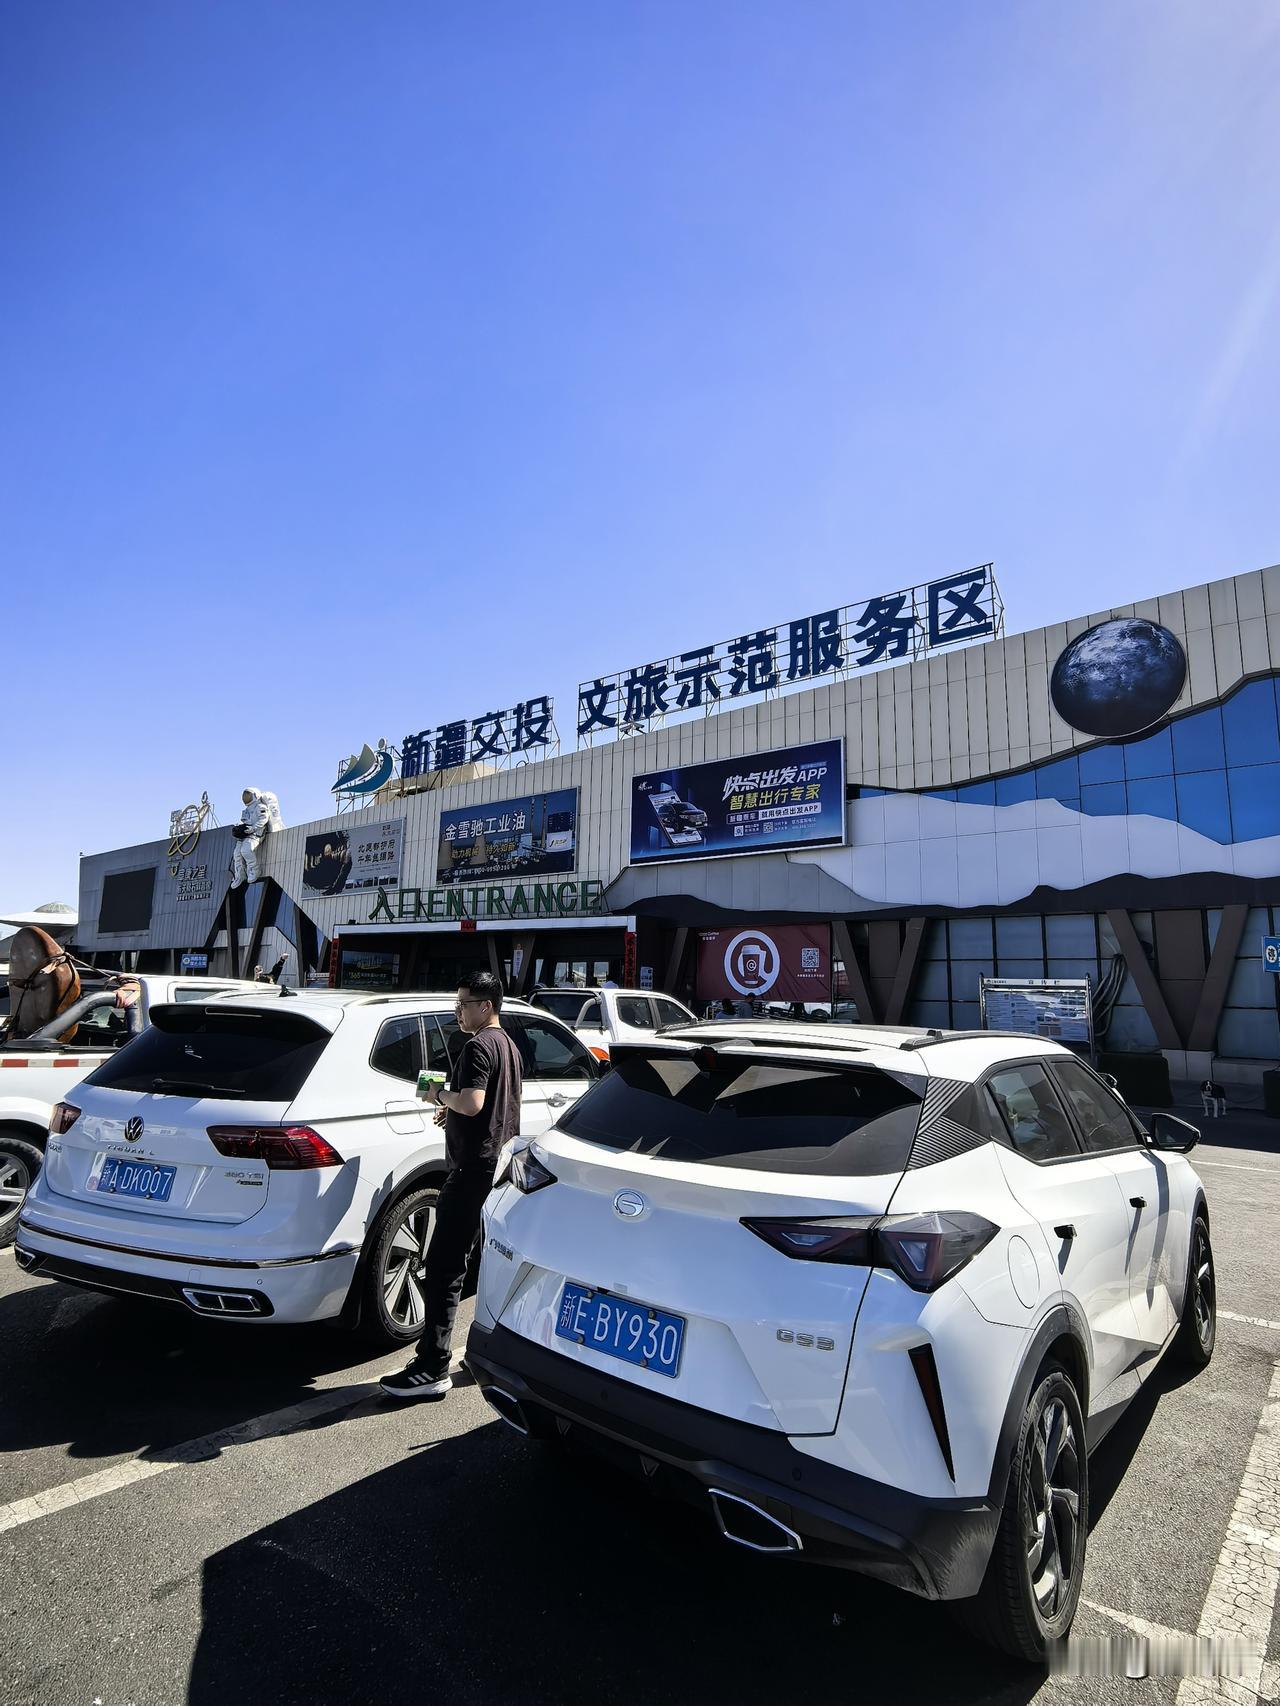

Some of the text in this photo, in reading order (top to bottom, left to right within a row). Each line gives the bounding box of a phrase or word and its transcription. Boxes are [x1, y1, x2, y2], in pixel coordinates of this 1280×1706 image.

[402, 569, 994, 778] 新疆交投 文旅示范服务区
[730, 784, 821, 811] 智慧出行专家
[444, 811, 526, 841] 金雪驰工业油
[428, 880, 603, 917] ENTRANCE
[776, 1328, 835, 1351] GS3
